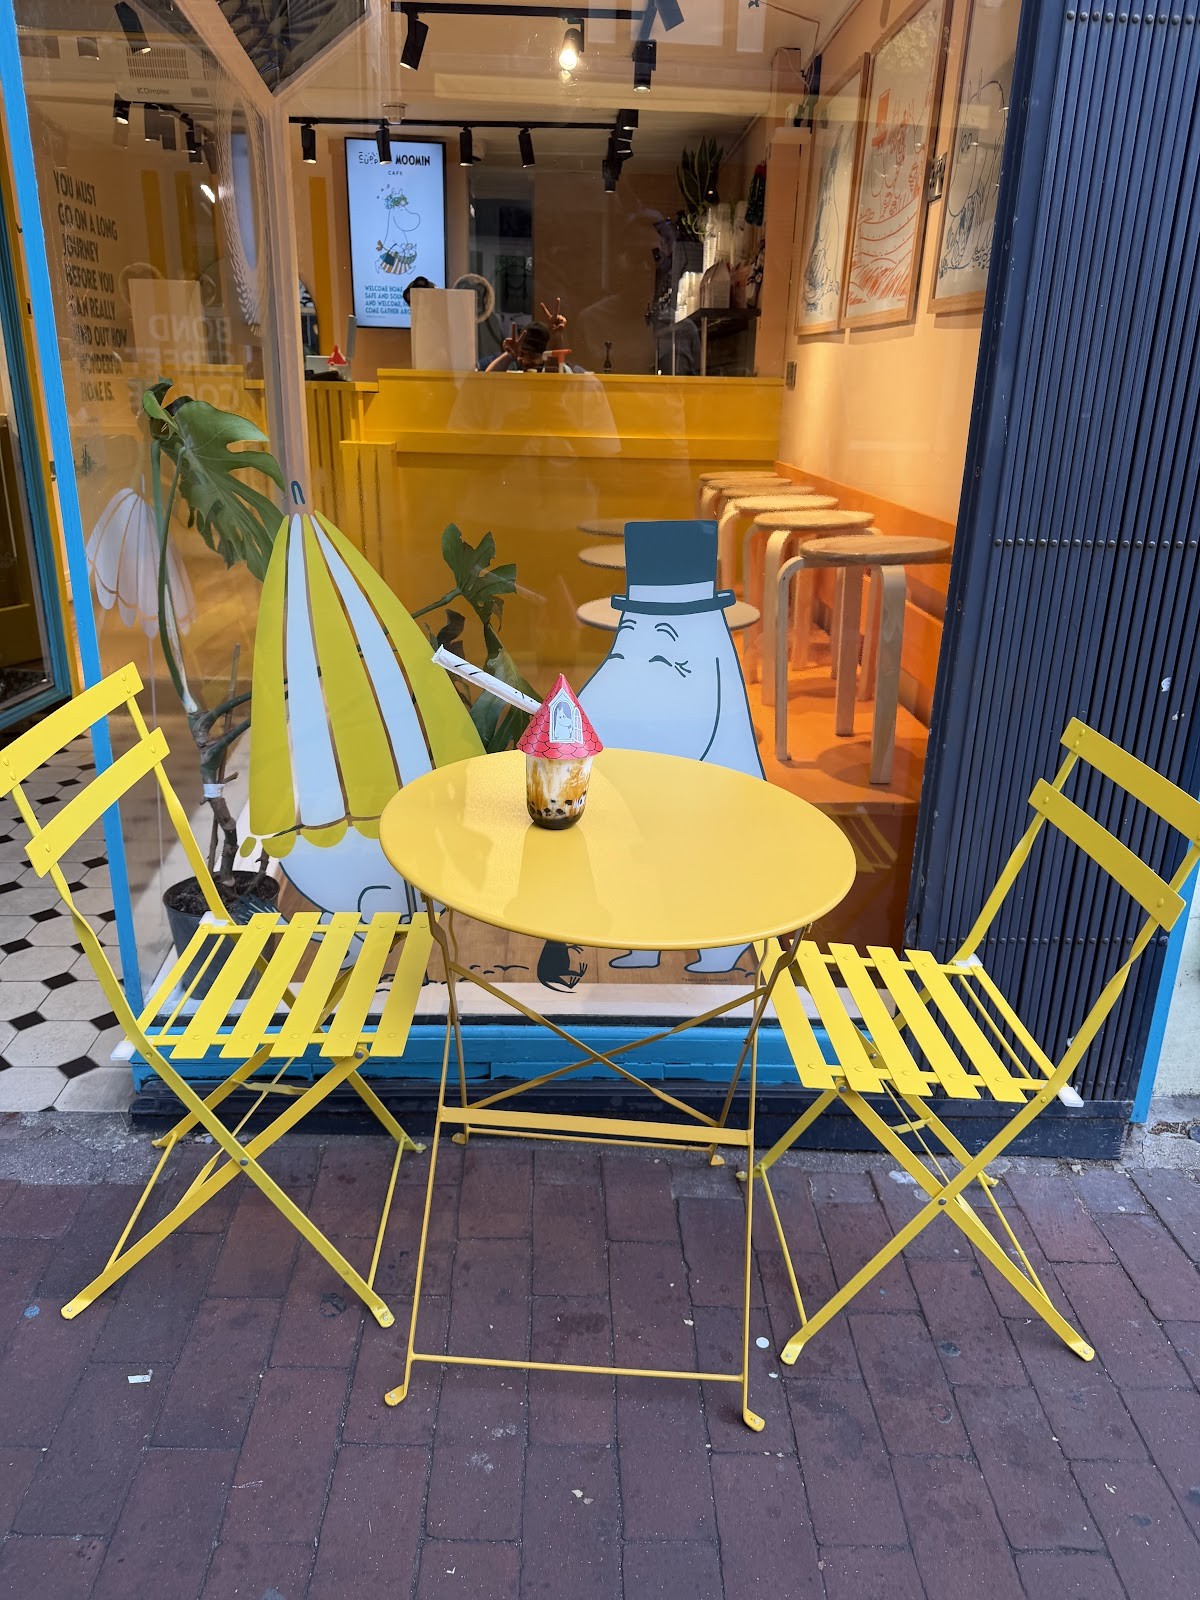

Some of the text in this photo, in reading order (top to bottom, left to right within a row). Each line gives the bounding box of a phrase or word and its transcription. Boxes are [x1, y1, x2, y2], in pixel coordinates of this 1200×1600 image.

[395, 154, 431, 166] MOOMIN
[53, 169, 97, 207] YOU MUST
[57, 202, 118, 241] GO ON A LONG
[62, 233, 100, 263] JOURNEY
[64, 263, 115, 294] BEFORE YOU
[88, 297, 116, 321] REALLY
[94, 326, 111, 347] OUT
[110, 327, 128, 348] HOW
